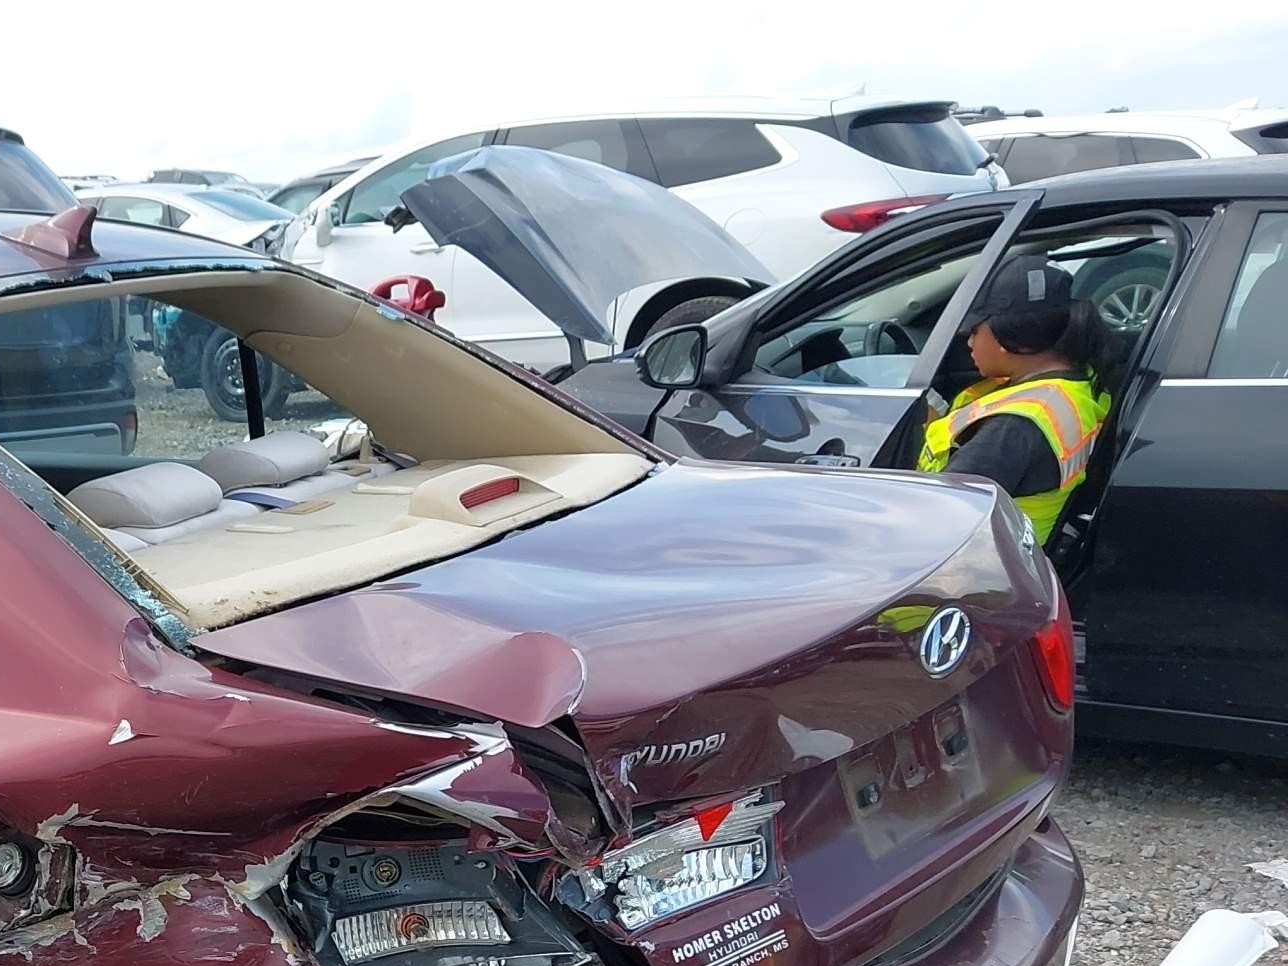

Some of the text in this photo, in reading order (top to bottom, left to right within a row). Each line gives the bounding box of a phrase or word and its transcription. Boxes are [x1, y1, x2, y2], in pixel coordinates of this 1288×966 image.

[672, 902, 782, 964] HOMER SKELTON
[708, 930, 760, 962] HYUNDAI
[773, 939, 790, 953] MS
